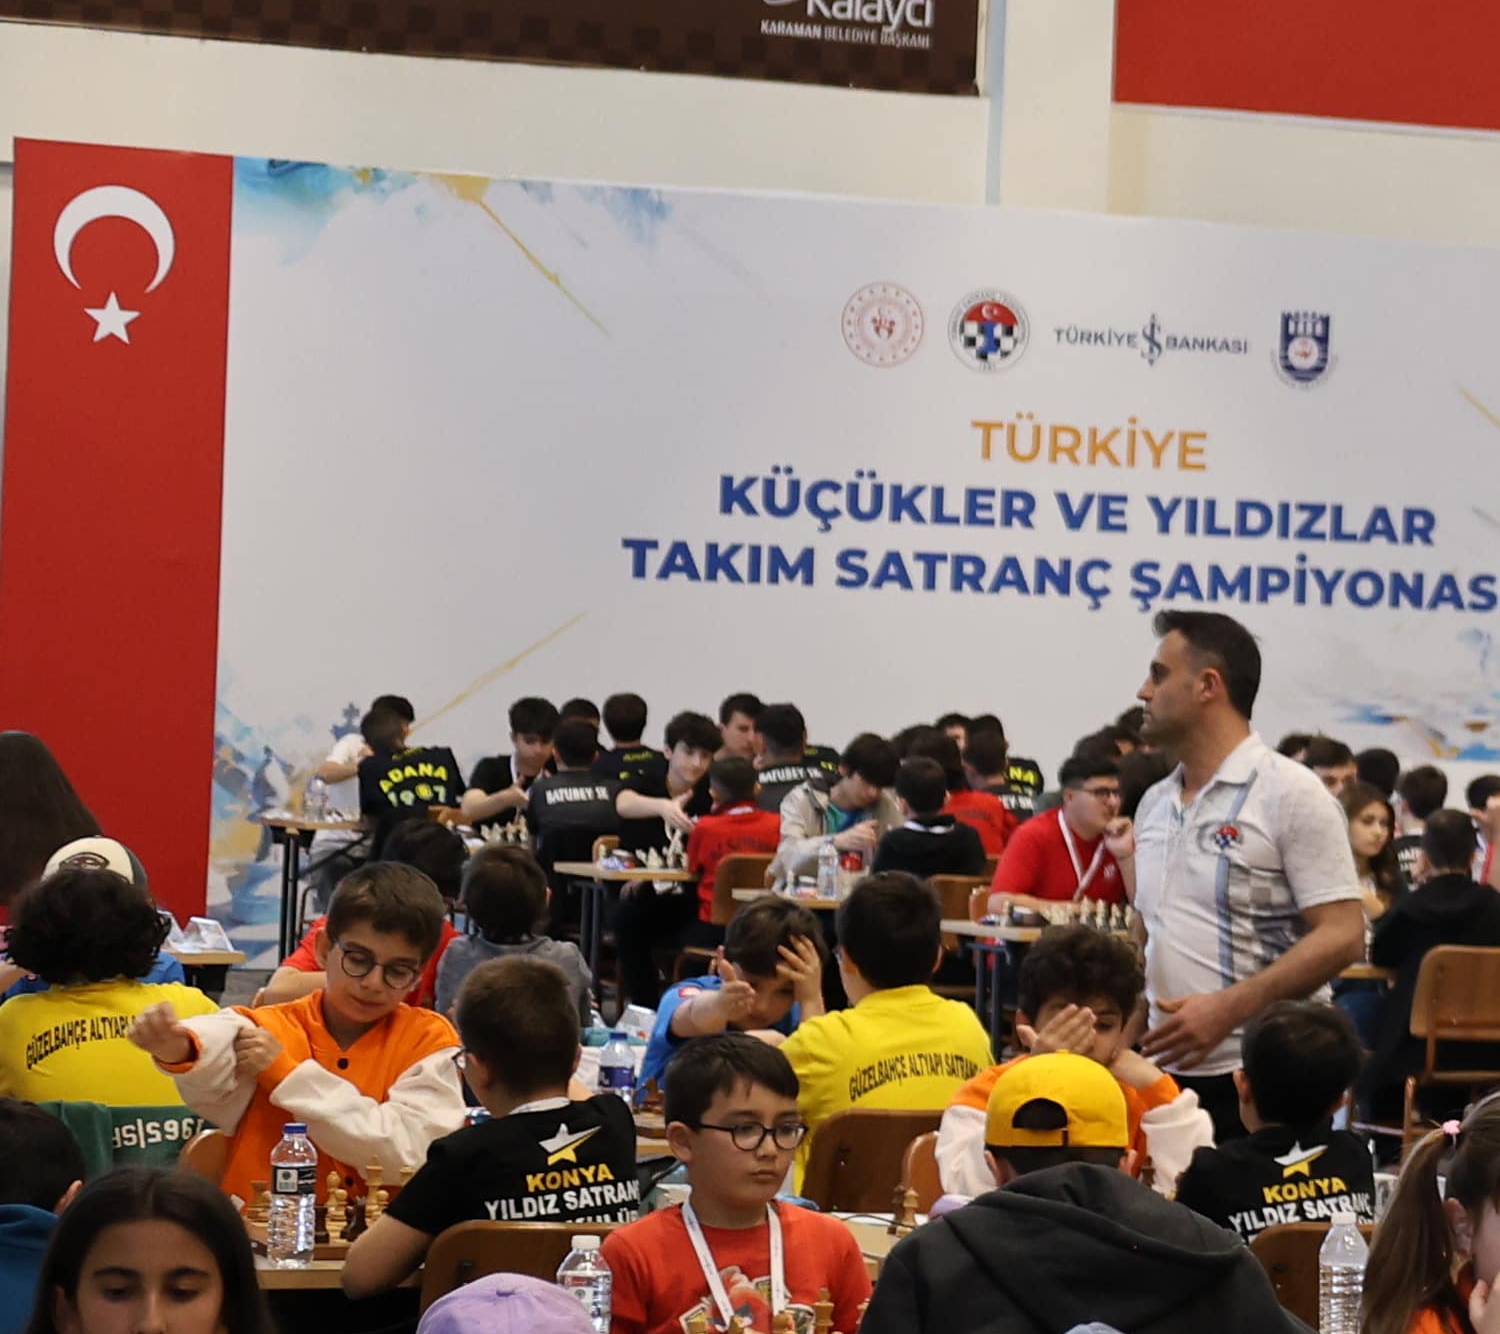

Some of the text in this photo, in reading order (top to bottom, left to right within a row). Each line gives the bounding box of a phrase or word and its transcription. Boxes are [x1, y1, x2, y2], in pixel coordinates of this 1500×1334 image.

[760, 19, 822, 40] KARAMAN
[1053, 326, 1138, 349] TÜRKİYE
[1166, 336, 1248, 355] BANKASI
[971, 414, 1208, 470] TÜRKİYE
[718, 465, 1436, 547] KÜÇÜKLER VE YILDIZLAR
[622, 537, 815, 586] TAKIM
[835, 547, 1112, 611] SATRANÇ
[378, 762, 448, 793] ADANA
[26, 1018, 87, 1070] GÜZELBAHÇE
[849, 1055, 907, 1102] GÜZELBAHÇE
[944, 1053, 979, 1080] SATRAN
[526, 1163, 615, 1193] KONYA
[1263, 1177, 1347, 1204] KONYA
[485, 1194, 560, 1221] YILDIZ
[563, 1179, 640, 1210] SATRAN
[1228, 1203, 1300, 1233] YILDIZ
